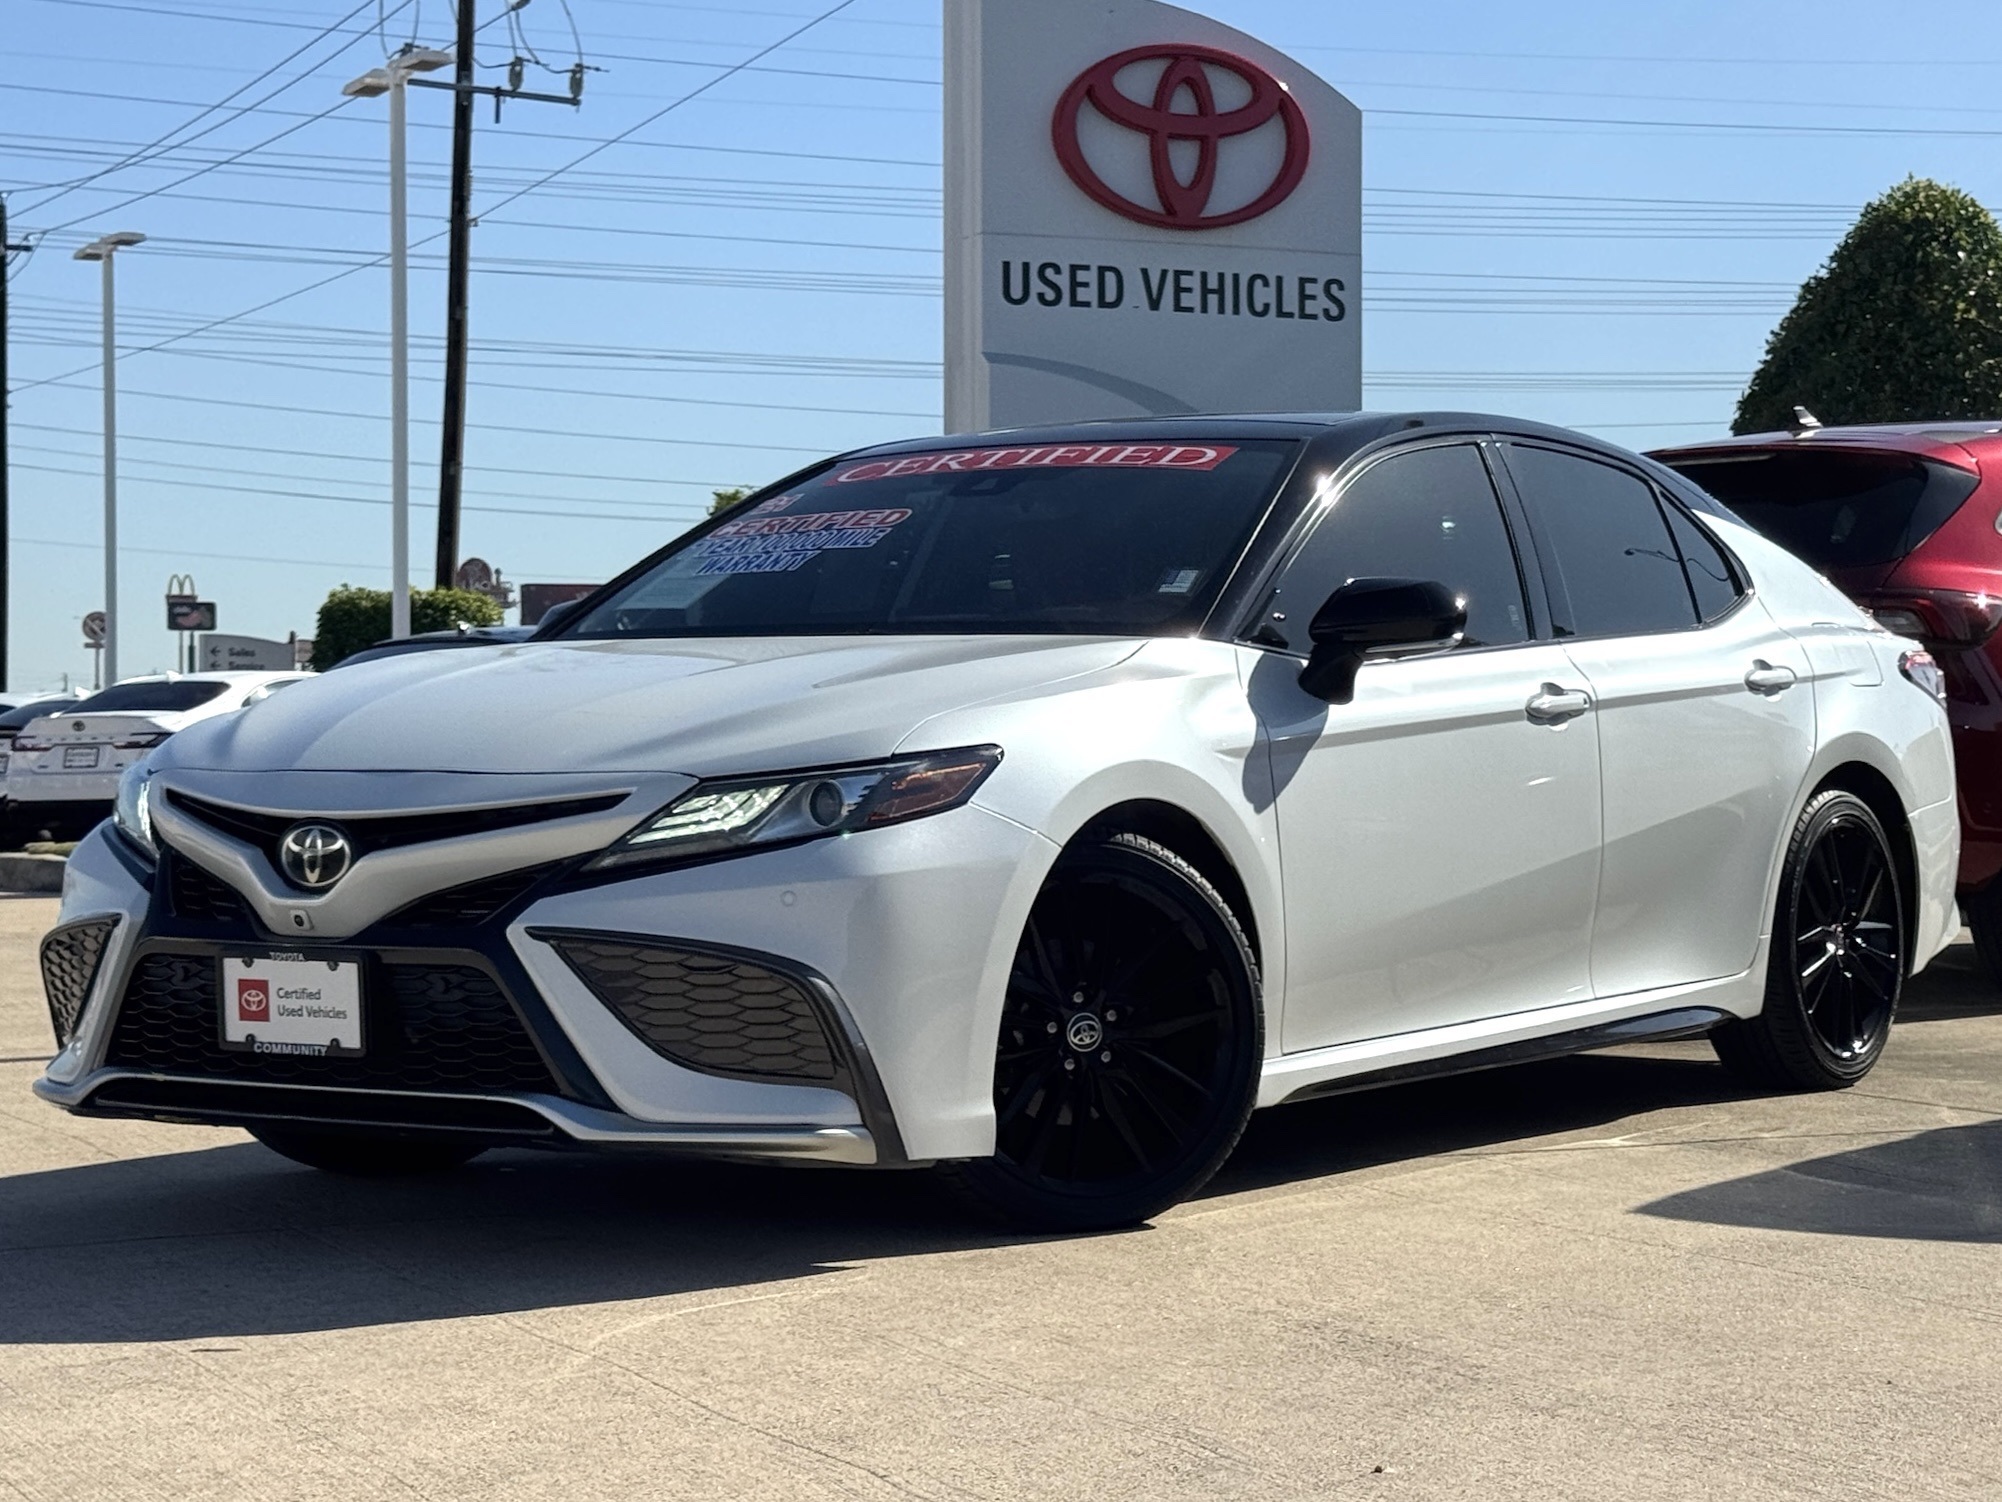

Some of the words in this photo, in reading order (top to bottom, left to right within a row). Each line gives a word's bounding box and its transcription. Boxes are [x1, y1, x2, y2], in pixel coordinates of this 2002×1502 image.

[1001, 260, 1124, 310] USED
[1140, 267, 1346, 323] VEHICLES
[837, 445, 1217, 484] CERTIFIED
[707, 508, 911, 540] CERTIFIED
[821, 527, 893, 549] MILE
[694, 550, 822, 576] WARRANTY
[269, 952, 305, 961] TOYOTA
[276, 987, 321, 1000] Certified
[277, 1004, 303, 1017] Used
[305, 1005, 347, 1019] Vehicles
[253, 1042, 327, 1056] COMMUNITY
